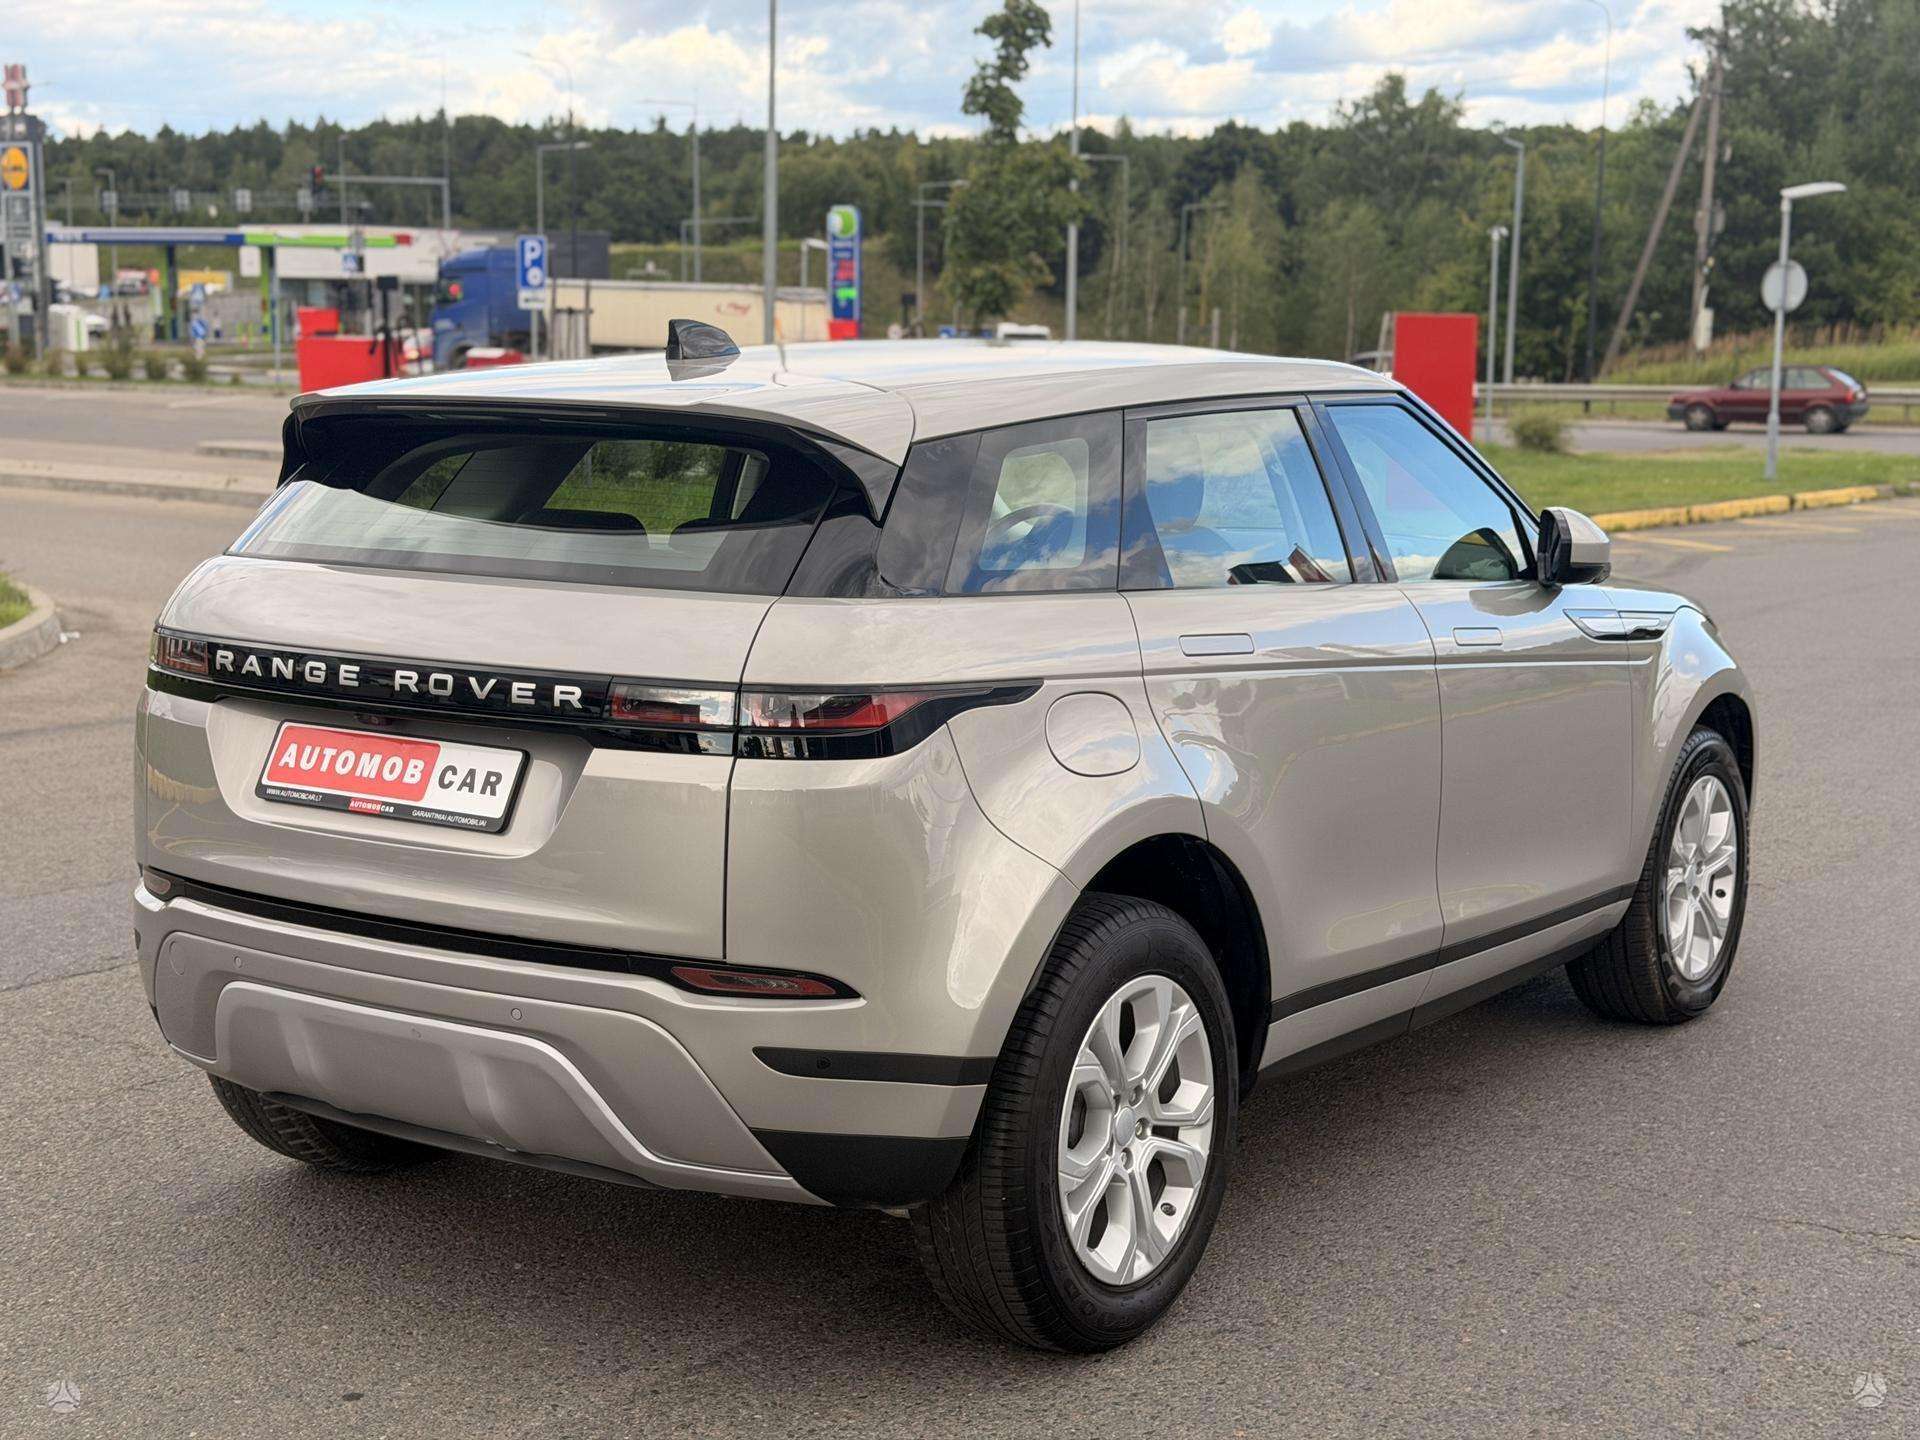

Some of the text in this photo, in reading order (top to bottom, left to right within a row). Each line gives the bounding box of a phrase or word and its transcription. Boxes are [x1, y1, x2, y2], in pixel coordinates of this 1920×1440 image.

[523, 239, 541, 268] P
[214, 649, 583, 709] RANGE ROVER
[278, 742, 503, 797] AUTOMOB CAR
[411, 809, 487, 827] GARANTINIAI AUTOMOBILIAI
